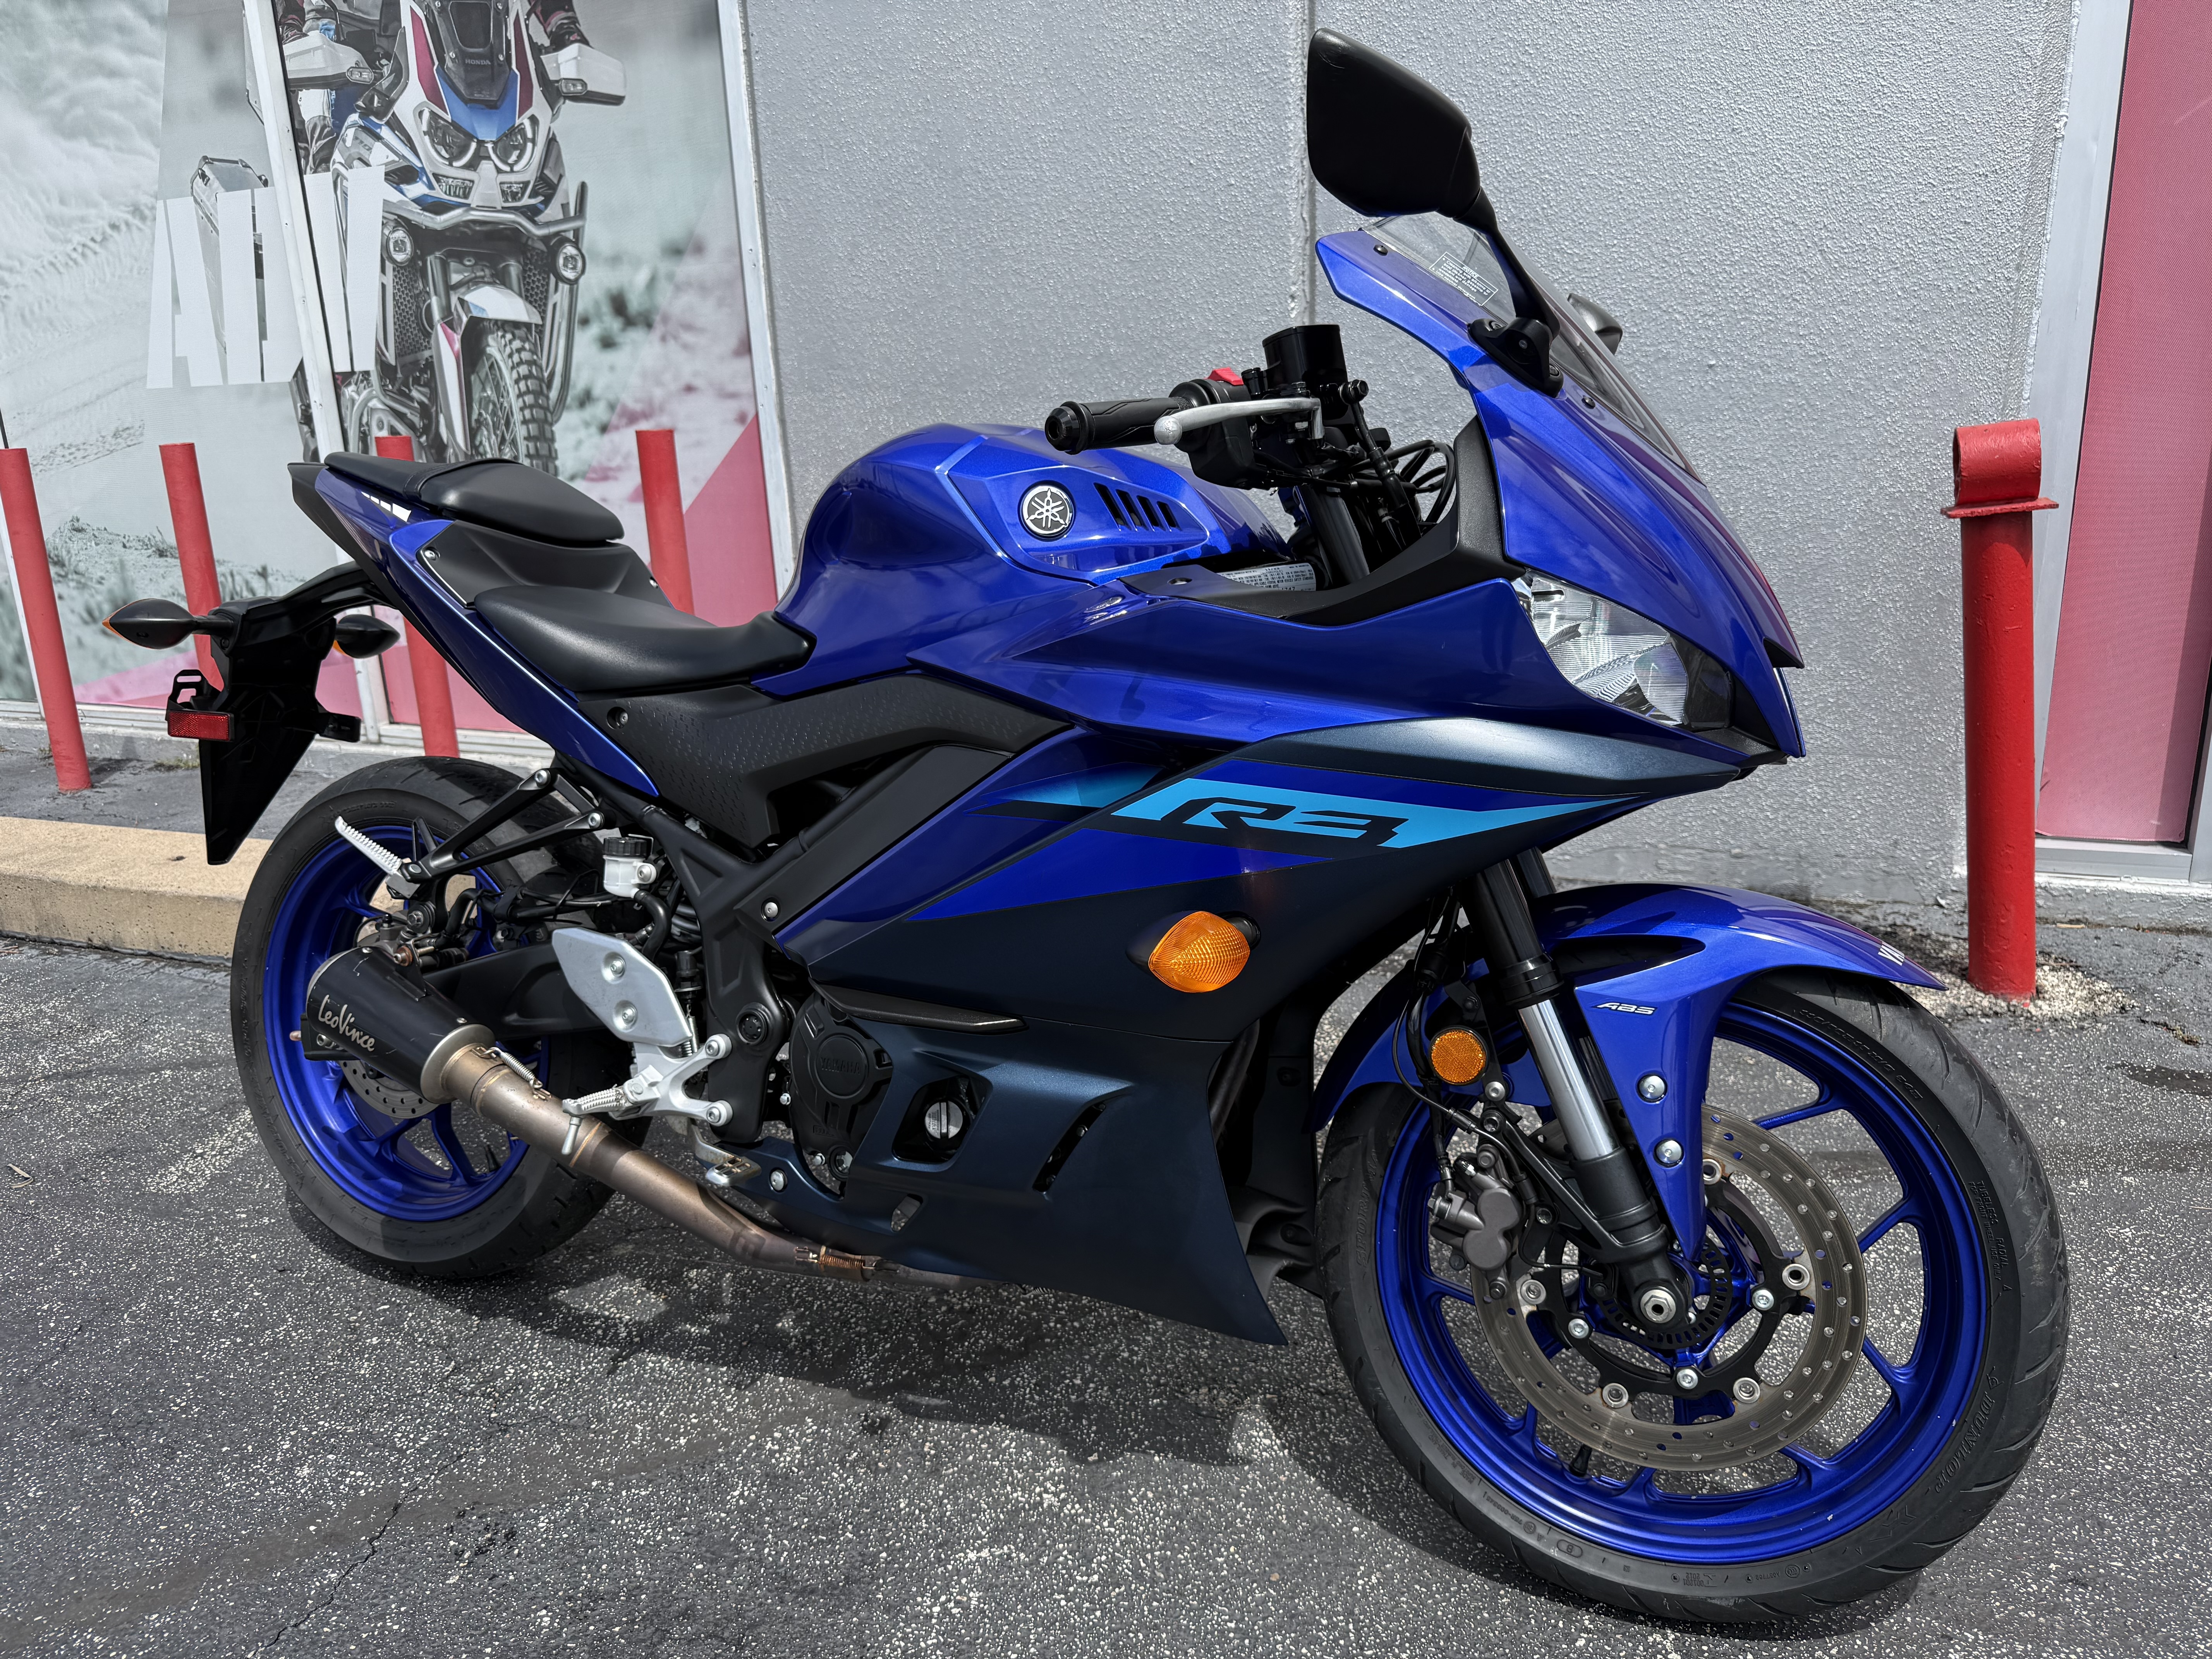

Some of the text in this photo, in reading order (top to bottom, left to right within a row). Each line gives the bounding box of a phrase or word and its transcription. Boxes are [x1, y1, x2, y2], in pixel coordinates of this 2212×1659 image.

[1160, 796, 1410, 847] R3
[318, 994, 375, 1051] LeoVince
[1596, 1002, 1655, 1015] ABS
[819, 1057, 861, 1075] YAMAHA
[1968, 1181, 2001, 1280] FOR FRONT WHEEL USE ONLY
[1976, 1180, 2009, 1268] TUBELESS RADIAL
[1934, 1391, 1995, 1494] DUNLOP
